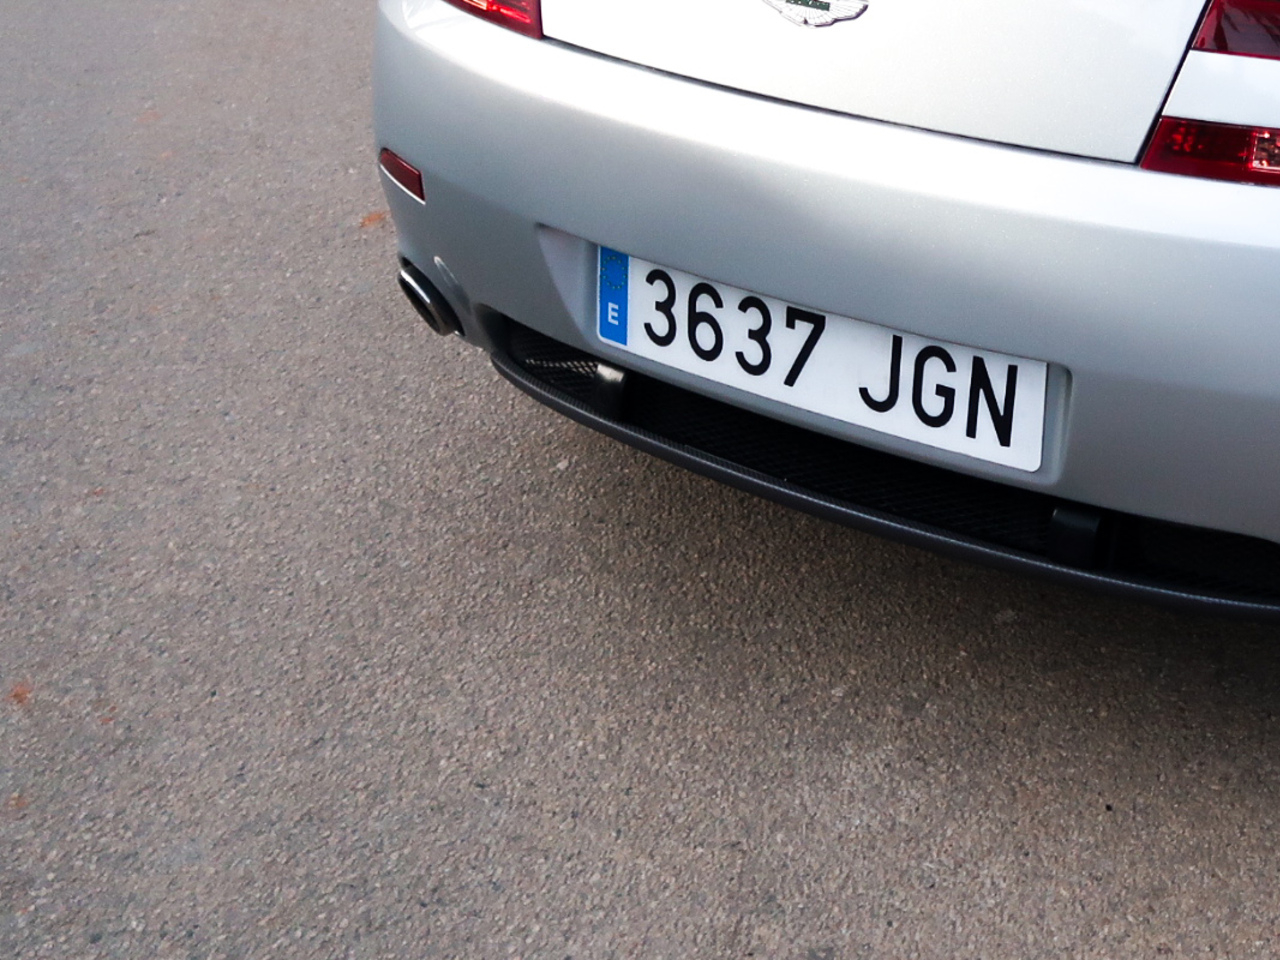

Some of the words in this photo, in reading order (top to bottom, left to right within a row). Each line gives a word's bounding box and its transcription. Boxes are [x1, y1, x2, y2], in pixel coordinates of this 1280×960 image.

[607, 302, 619, 326] E
[644, 269, 827, 387] 3637
[858, 334, 1019, 448] JGN
